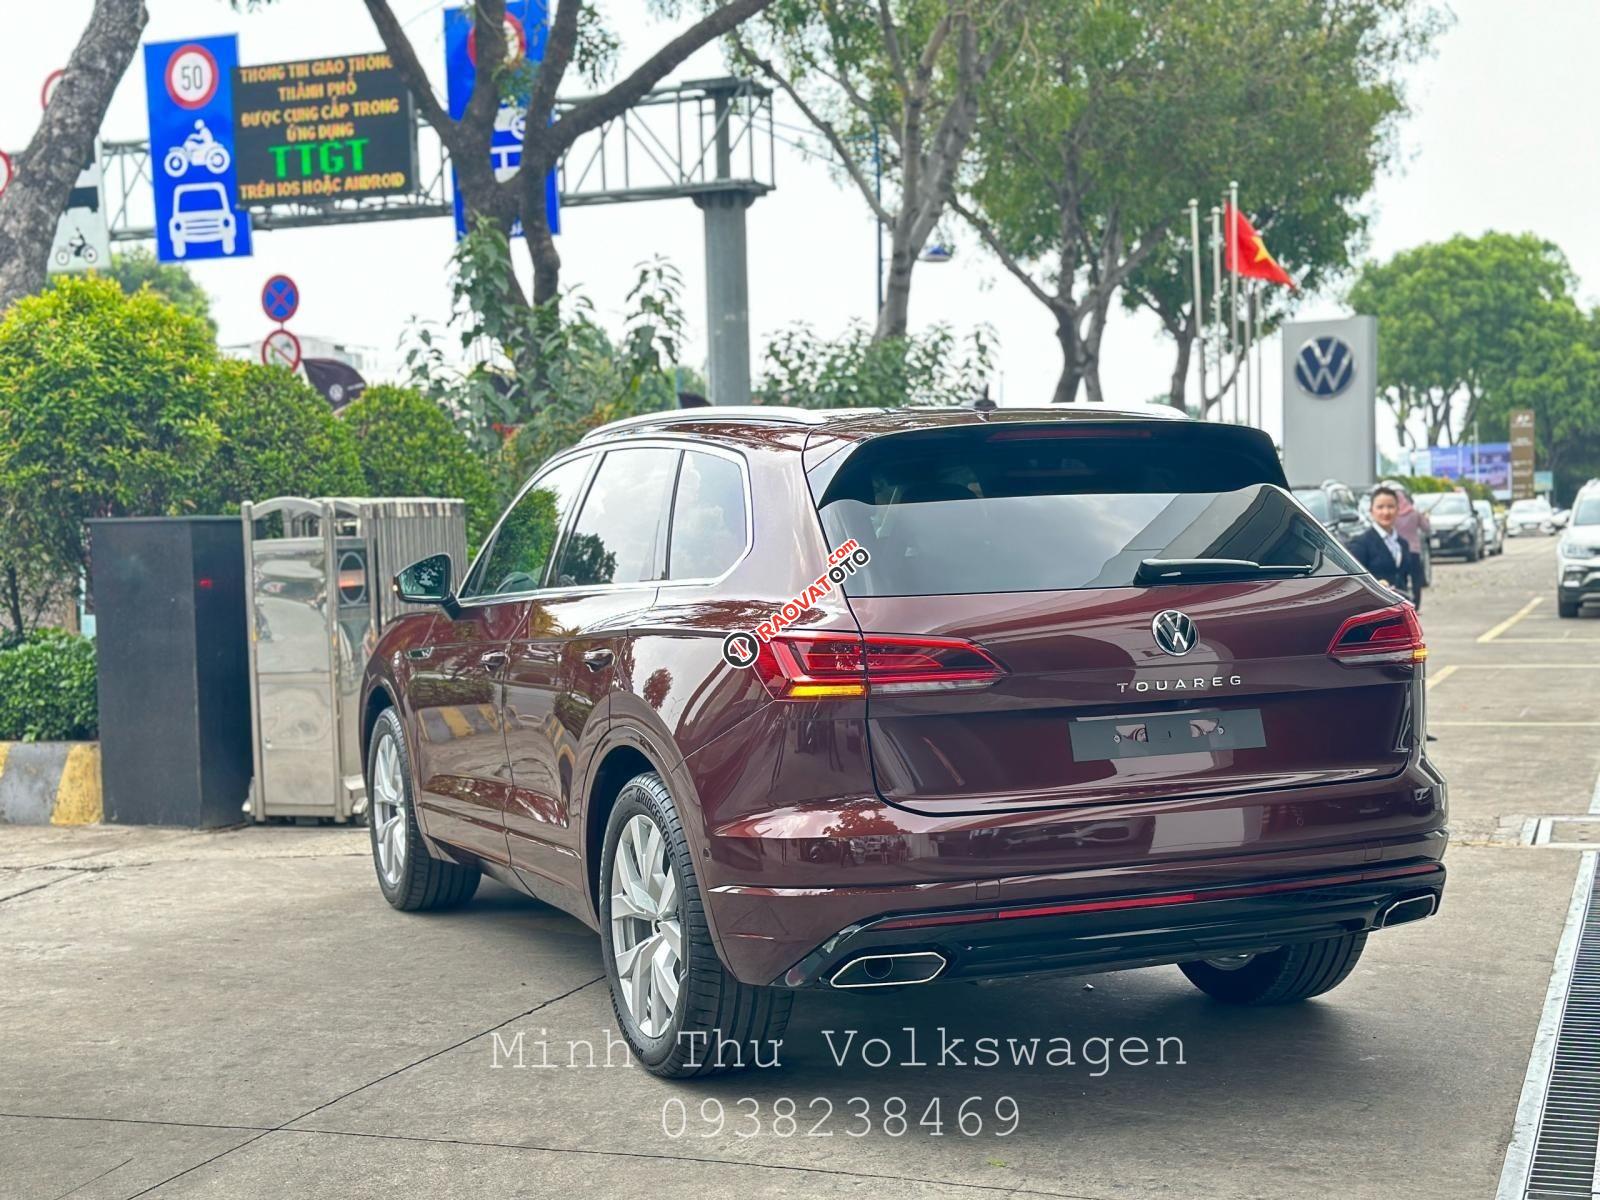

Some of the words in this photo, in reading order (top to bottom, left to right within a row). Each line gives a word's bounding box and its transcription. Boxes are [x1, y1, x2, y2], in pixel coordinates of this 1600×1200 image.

[181, 65, 203, 90] 50
[311, 58, 345, 77] GIAO
[283, 105, 319, 122] CUNG
[352, 98, 399, 116] TRONG
[268, 137, 369, 178] TTGT
[344, 172, 405, 191] ANDROID
[1117, 675, 1241, 693] TOUAREG
